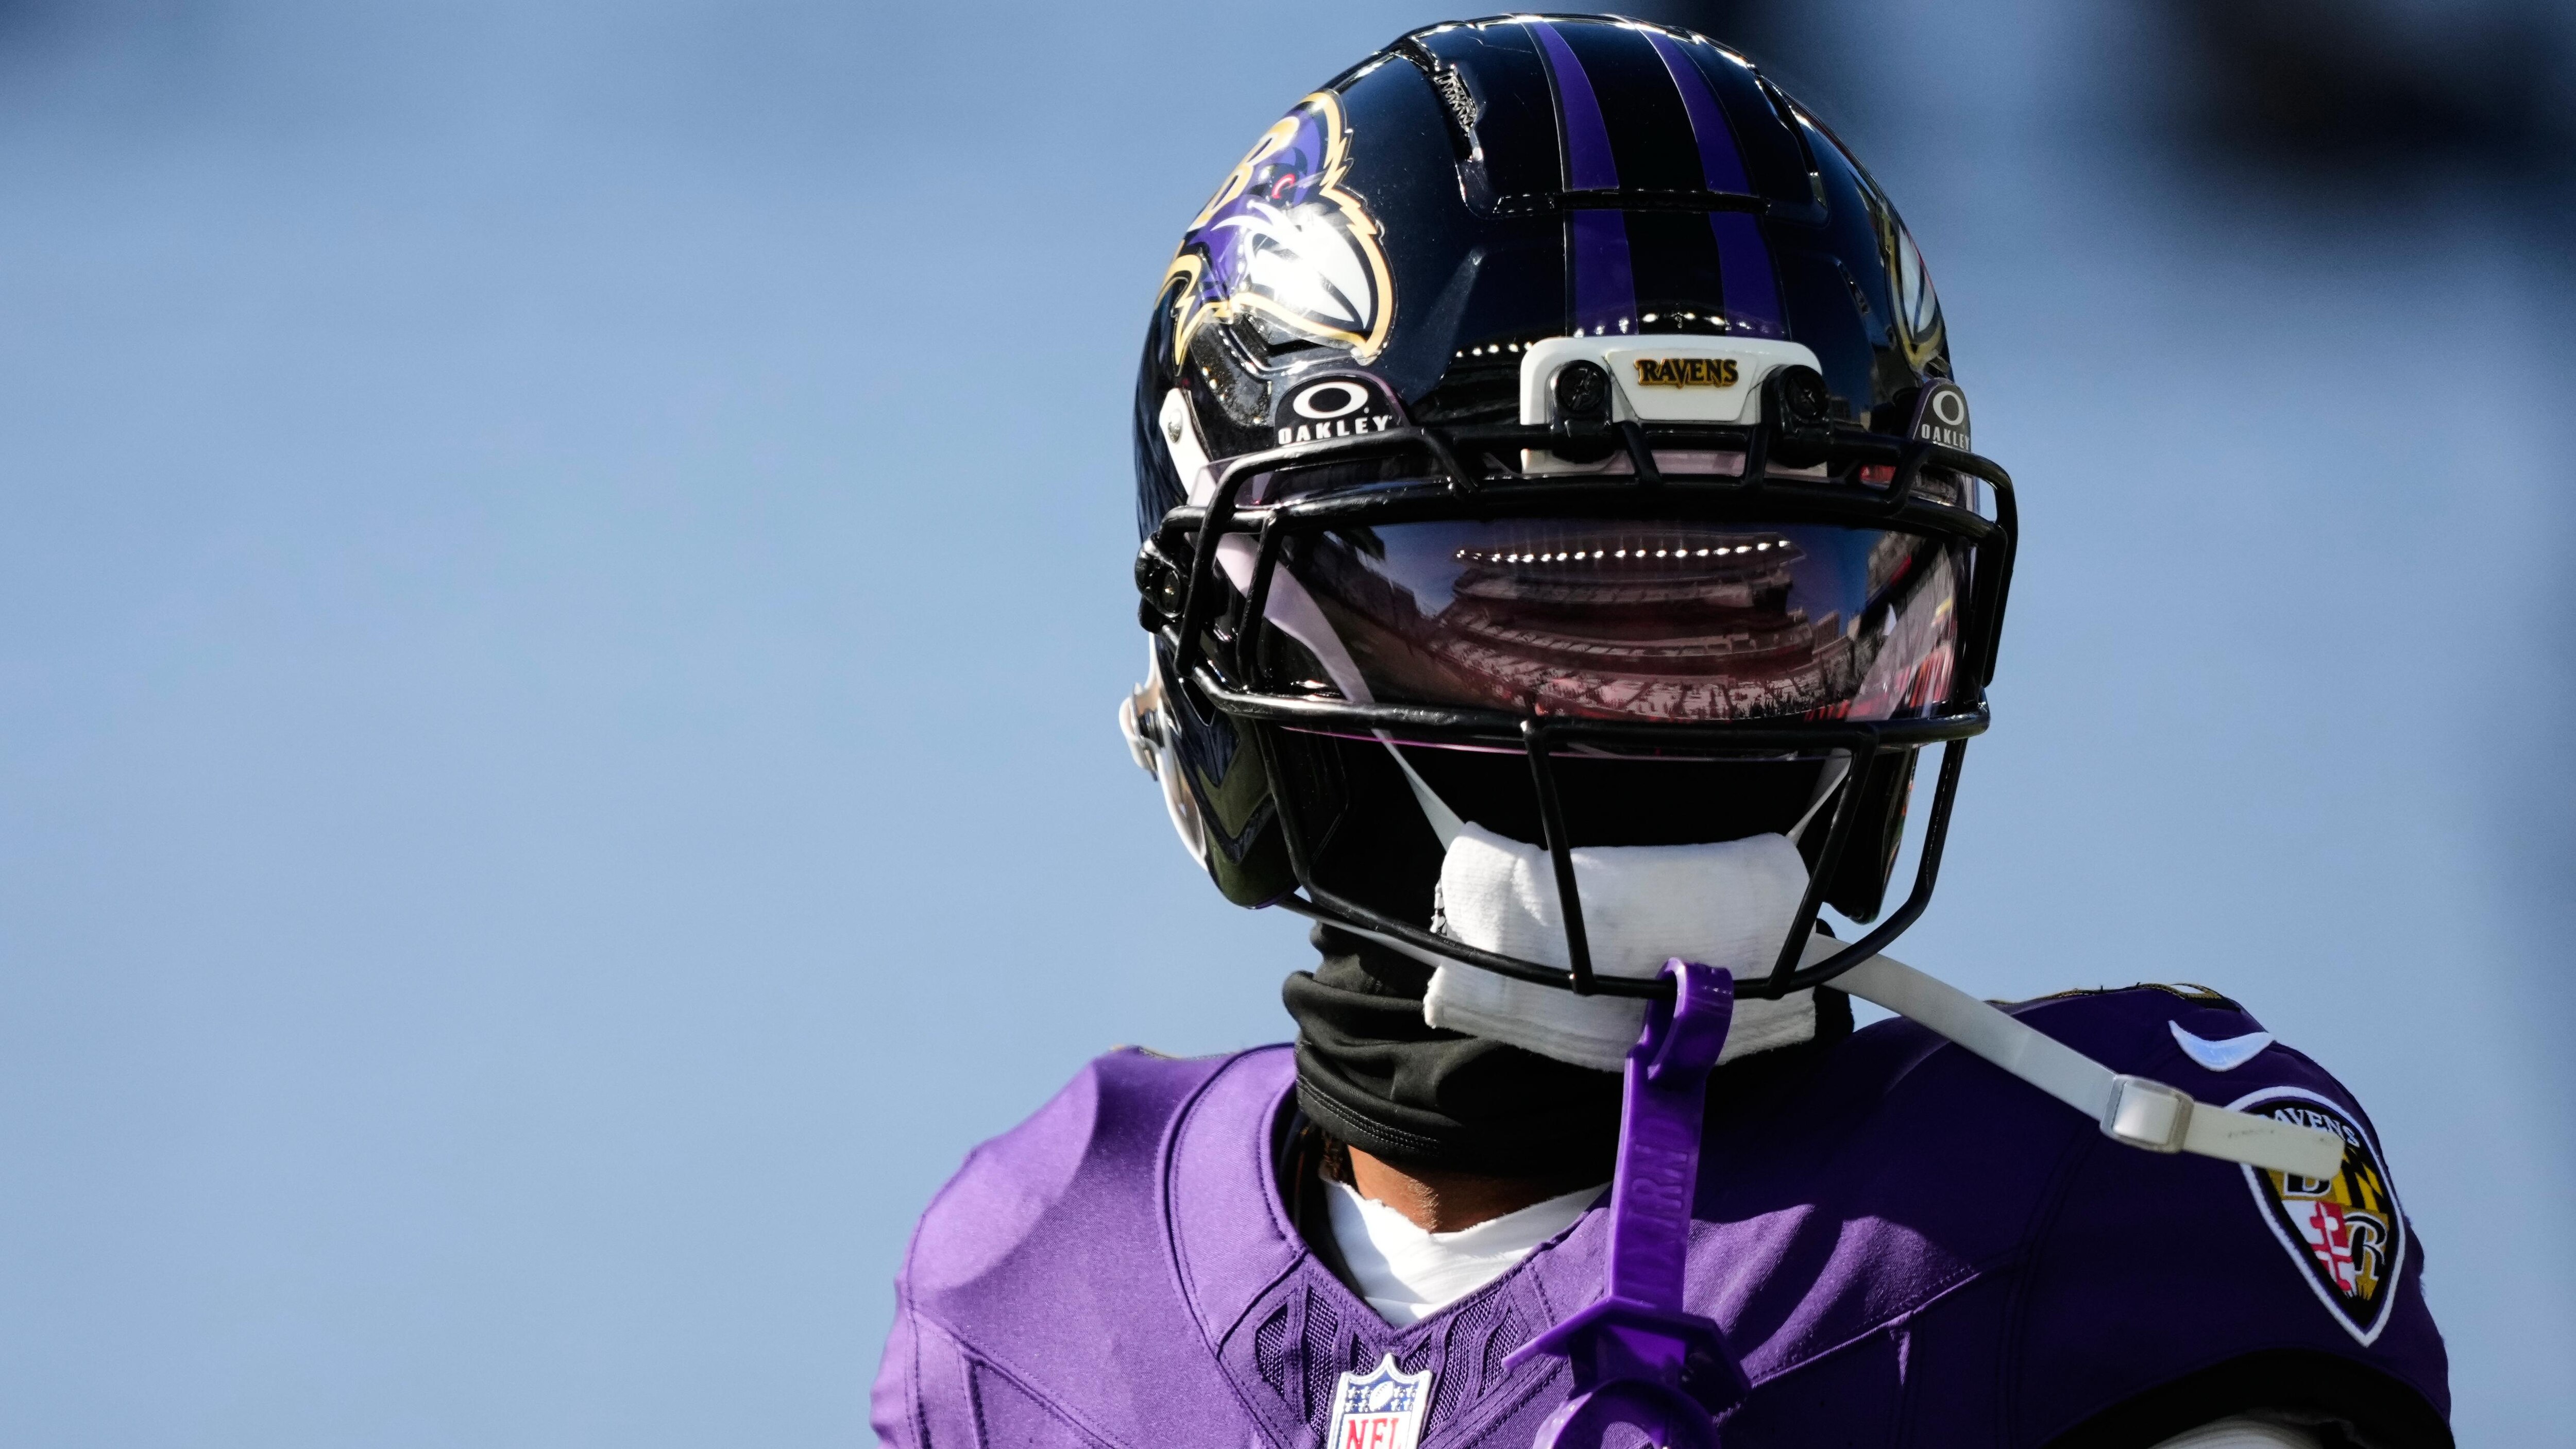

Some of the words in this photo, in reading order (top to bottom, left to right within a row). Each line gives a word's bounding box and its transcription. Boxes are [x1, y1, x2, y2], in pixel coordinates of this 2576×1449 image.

[1634, 358, 1738, 389] RAVENS
[1278, 414, 1389, 445] OAKLEY
[1921, 424, 1970, 450] OAKLEY
[2259, 1108, 2360, 1148] AVENS
